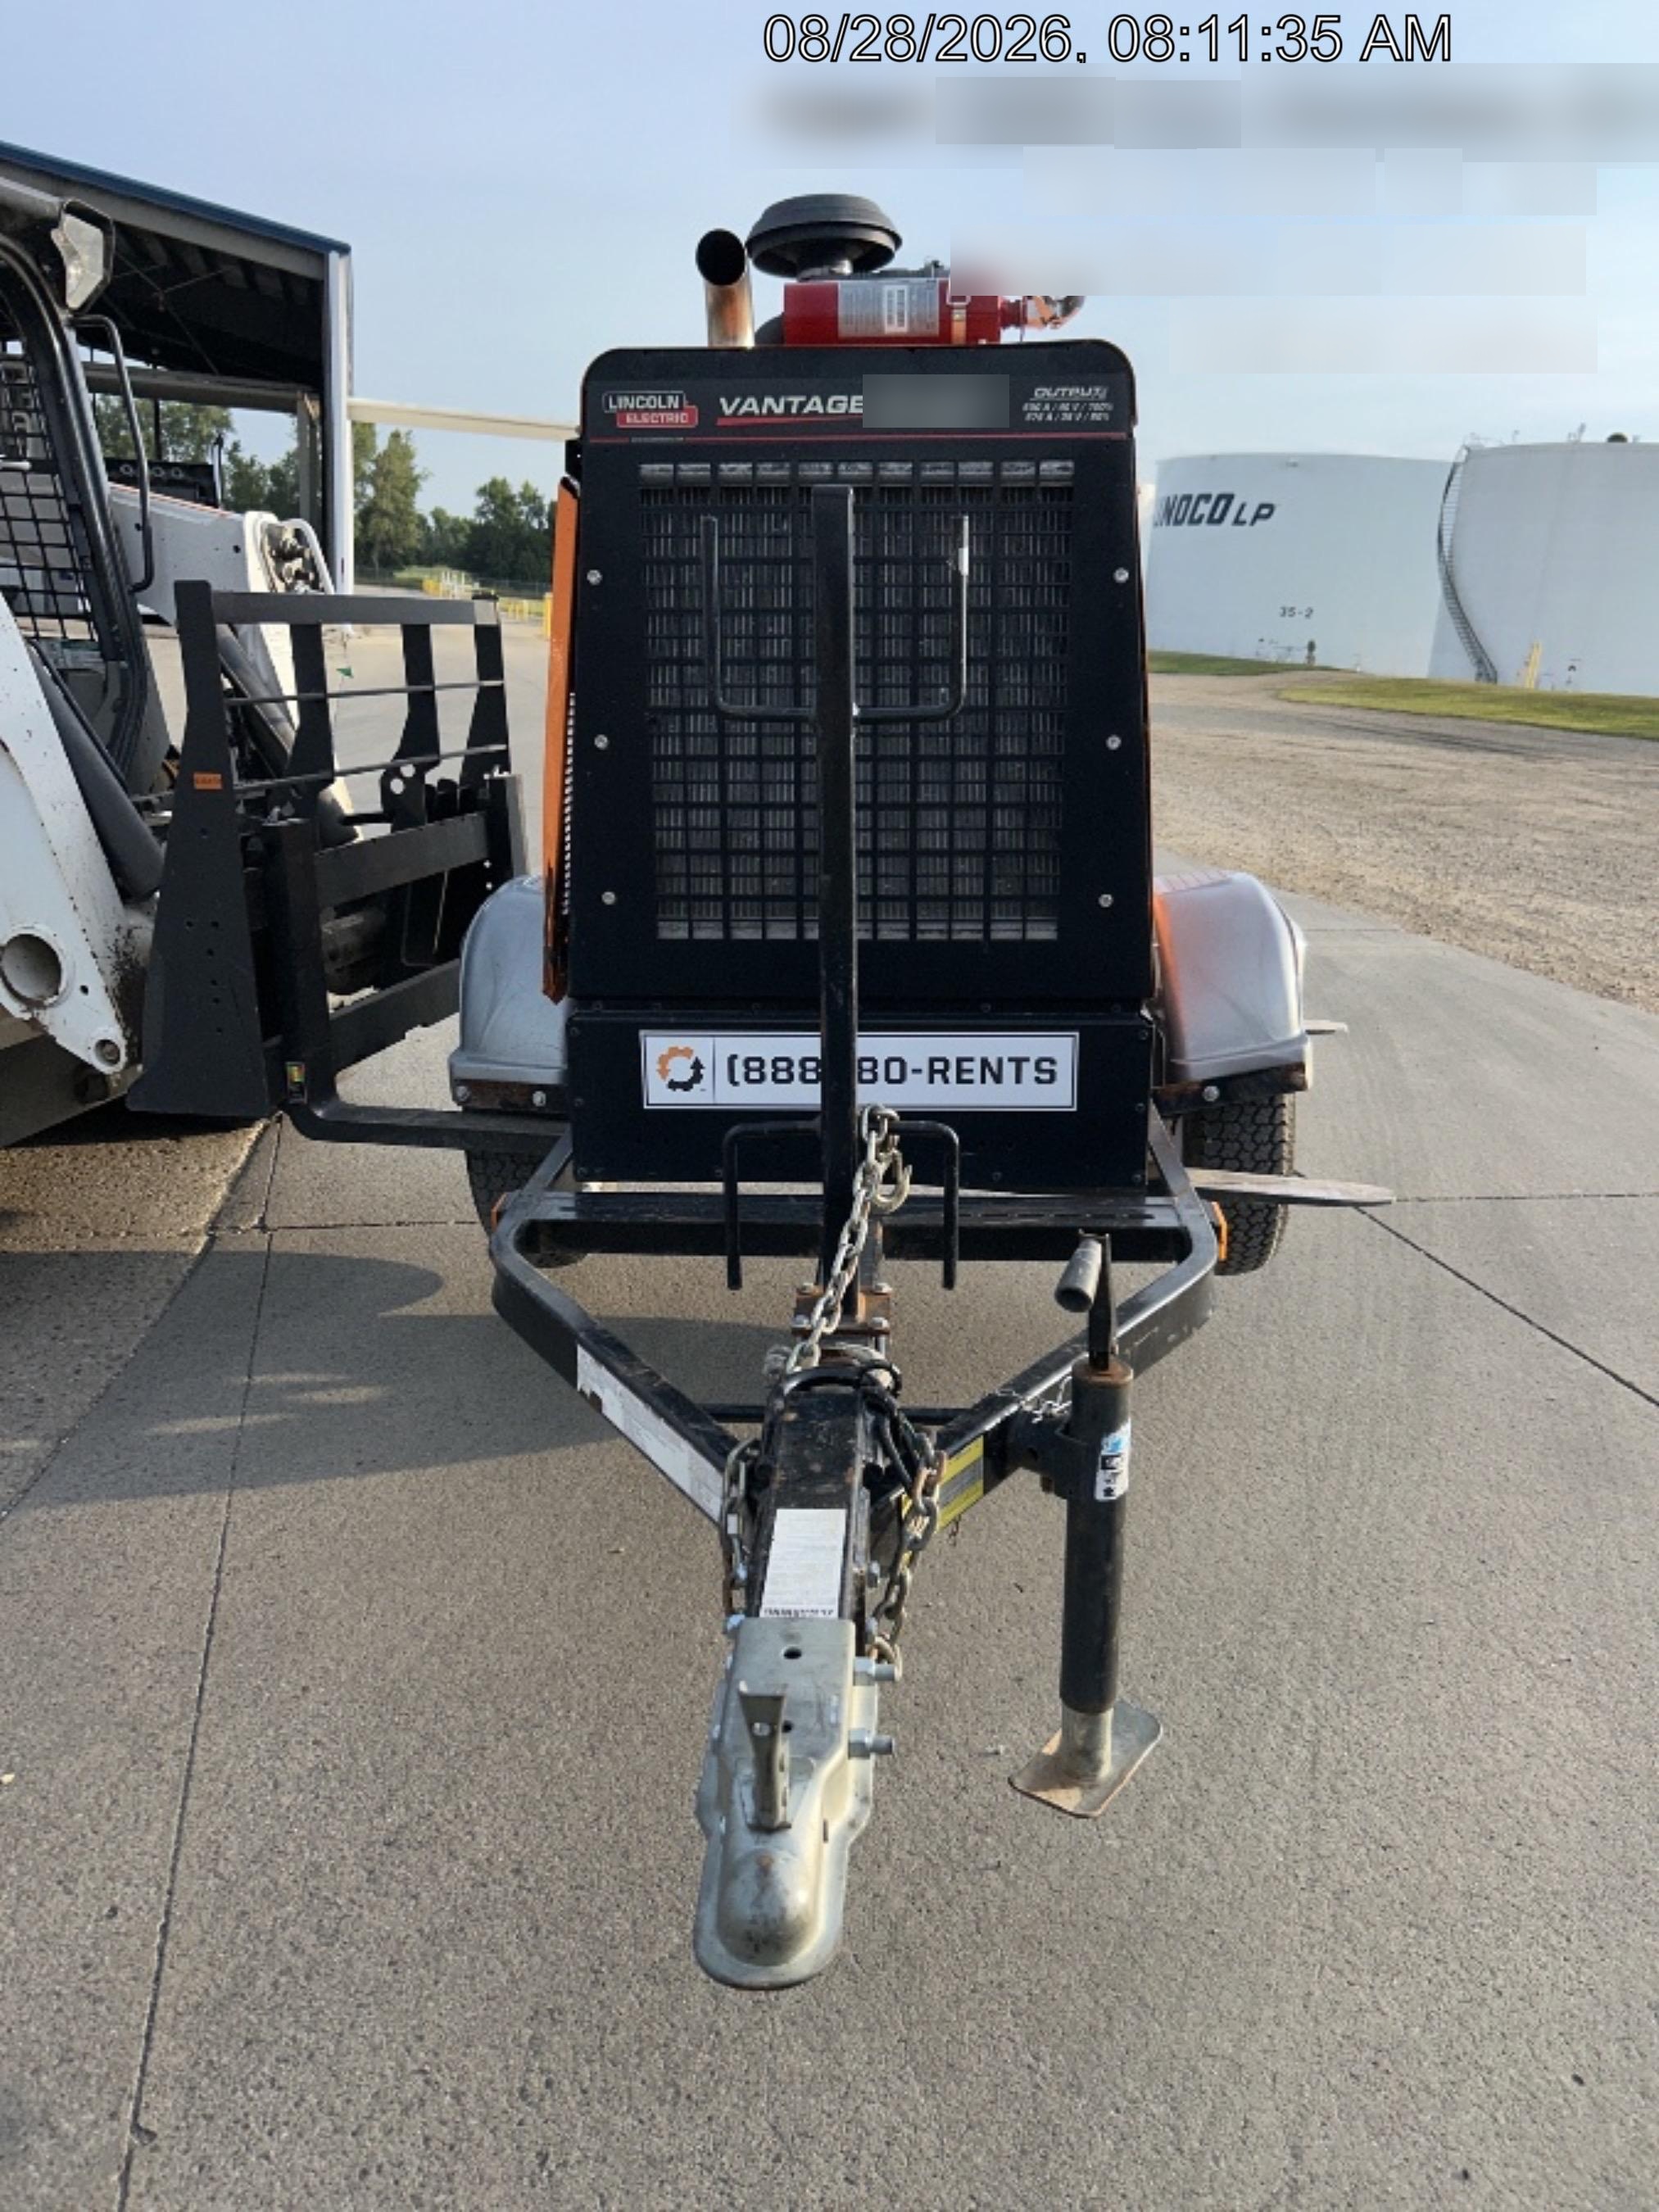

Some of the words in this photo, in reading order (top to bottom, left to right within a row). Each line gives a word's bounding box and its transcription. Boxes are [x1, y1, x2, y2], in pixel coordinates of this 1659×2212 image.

[608, 394, 680, 410] LINCOLN
[625, 412, 690, 424] ELECTRIC
[1231, 502, 1276, 527] LP
